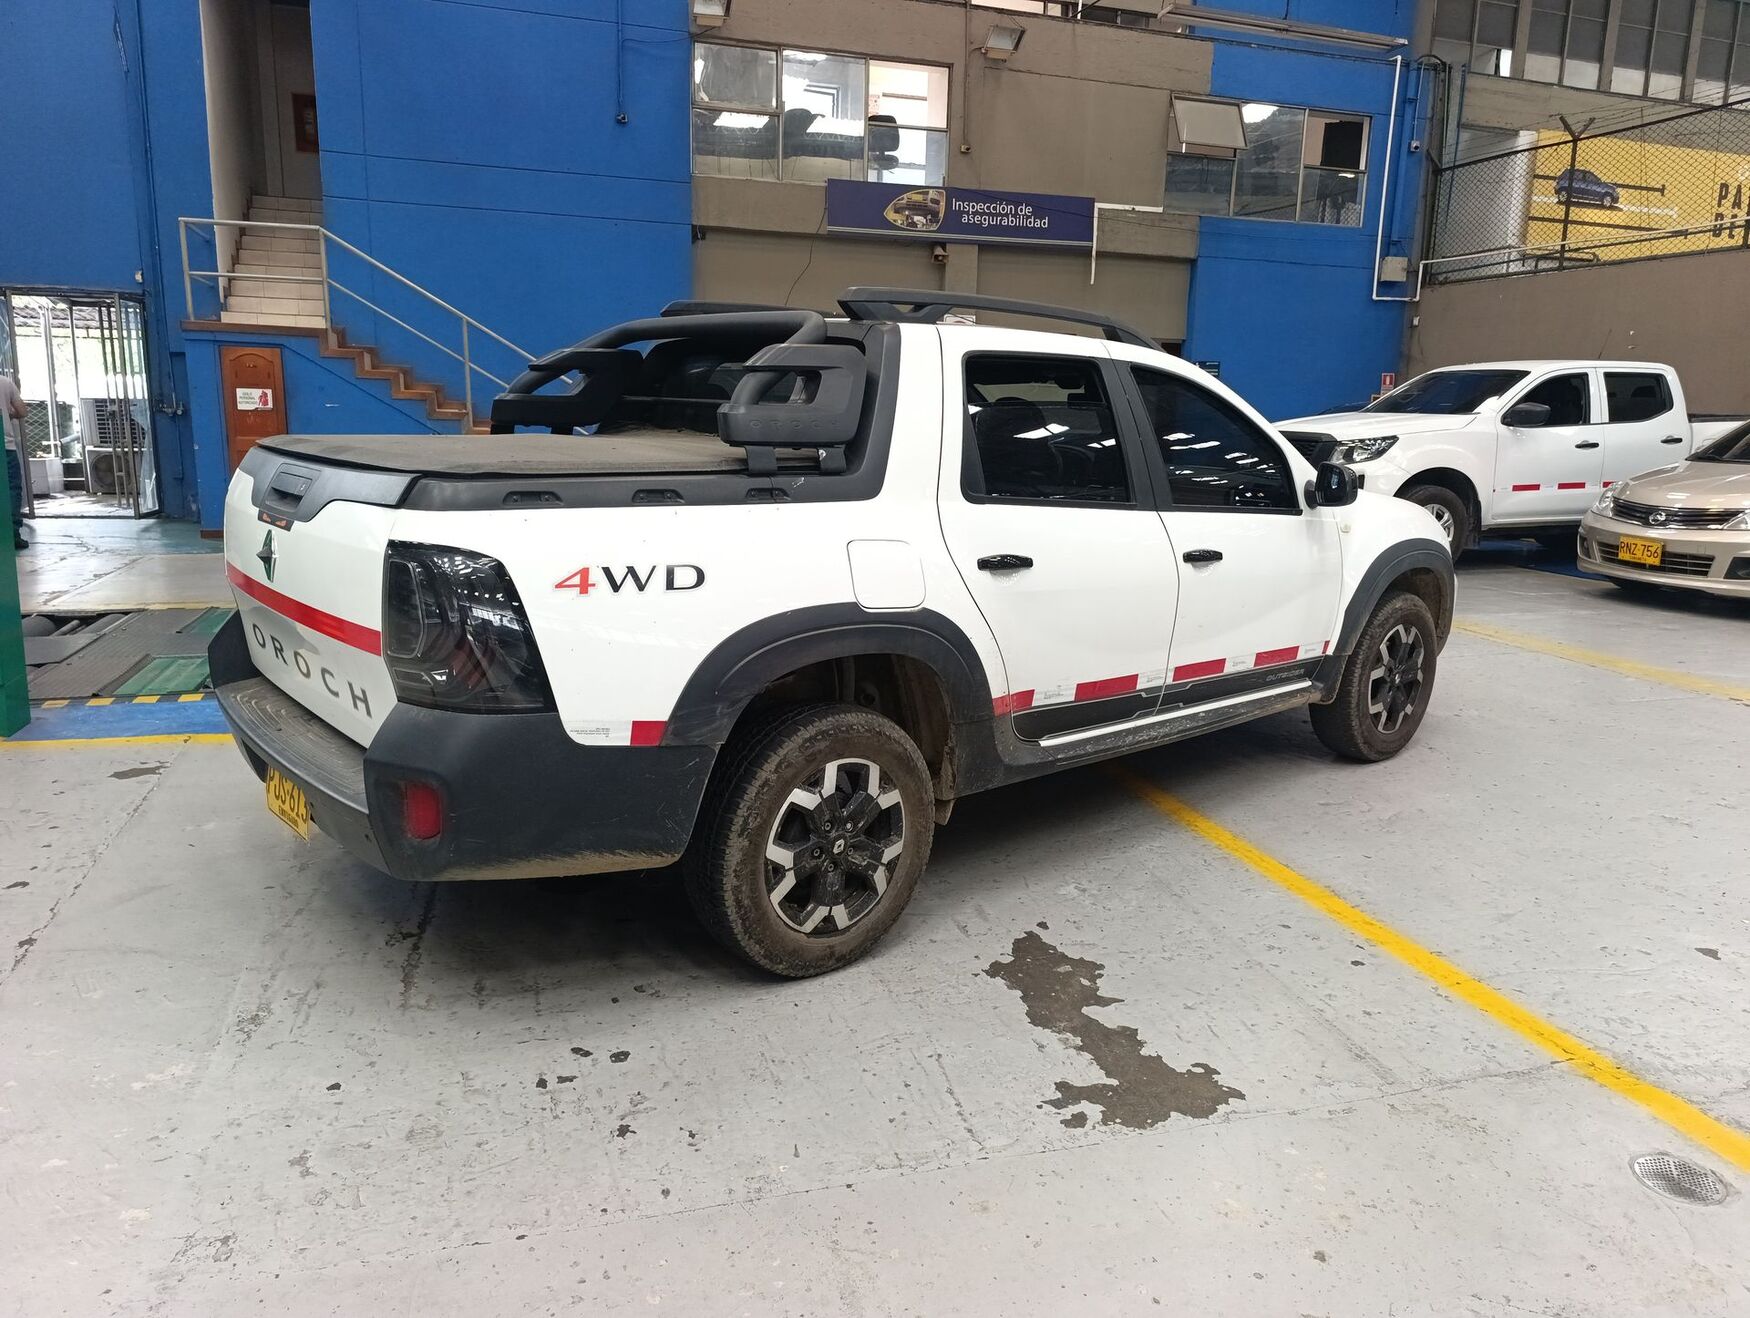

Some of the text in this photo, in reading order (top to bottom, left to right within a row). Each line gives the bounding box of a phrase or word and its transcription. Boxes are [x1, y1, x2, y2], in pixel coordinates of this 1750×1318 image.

[952, 198, 1033, 216] Inspección de
[961, 214, 1049, 228] asegurabilidad
[1620, 541, 1638, 556] RNZ
[1641, 544, 1659, 559] 756
[554, 564, 706, 595] 4WD
[252, 622, 373, 719] OROCH
